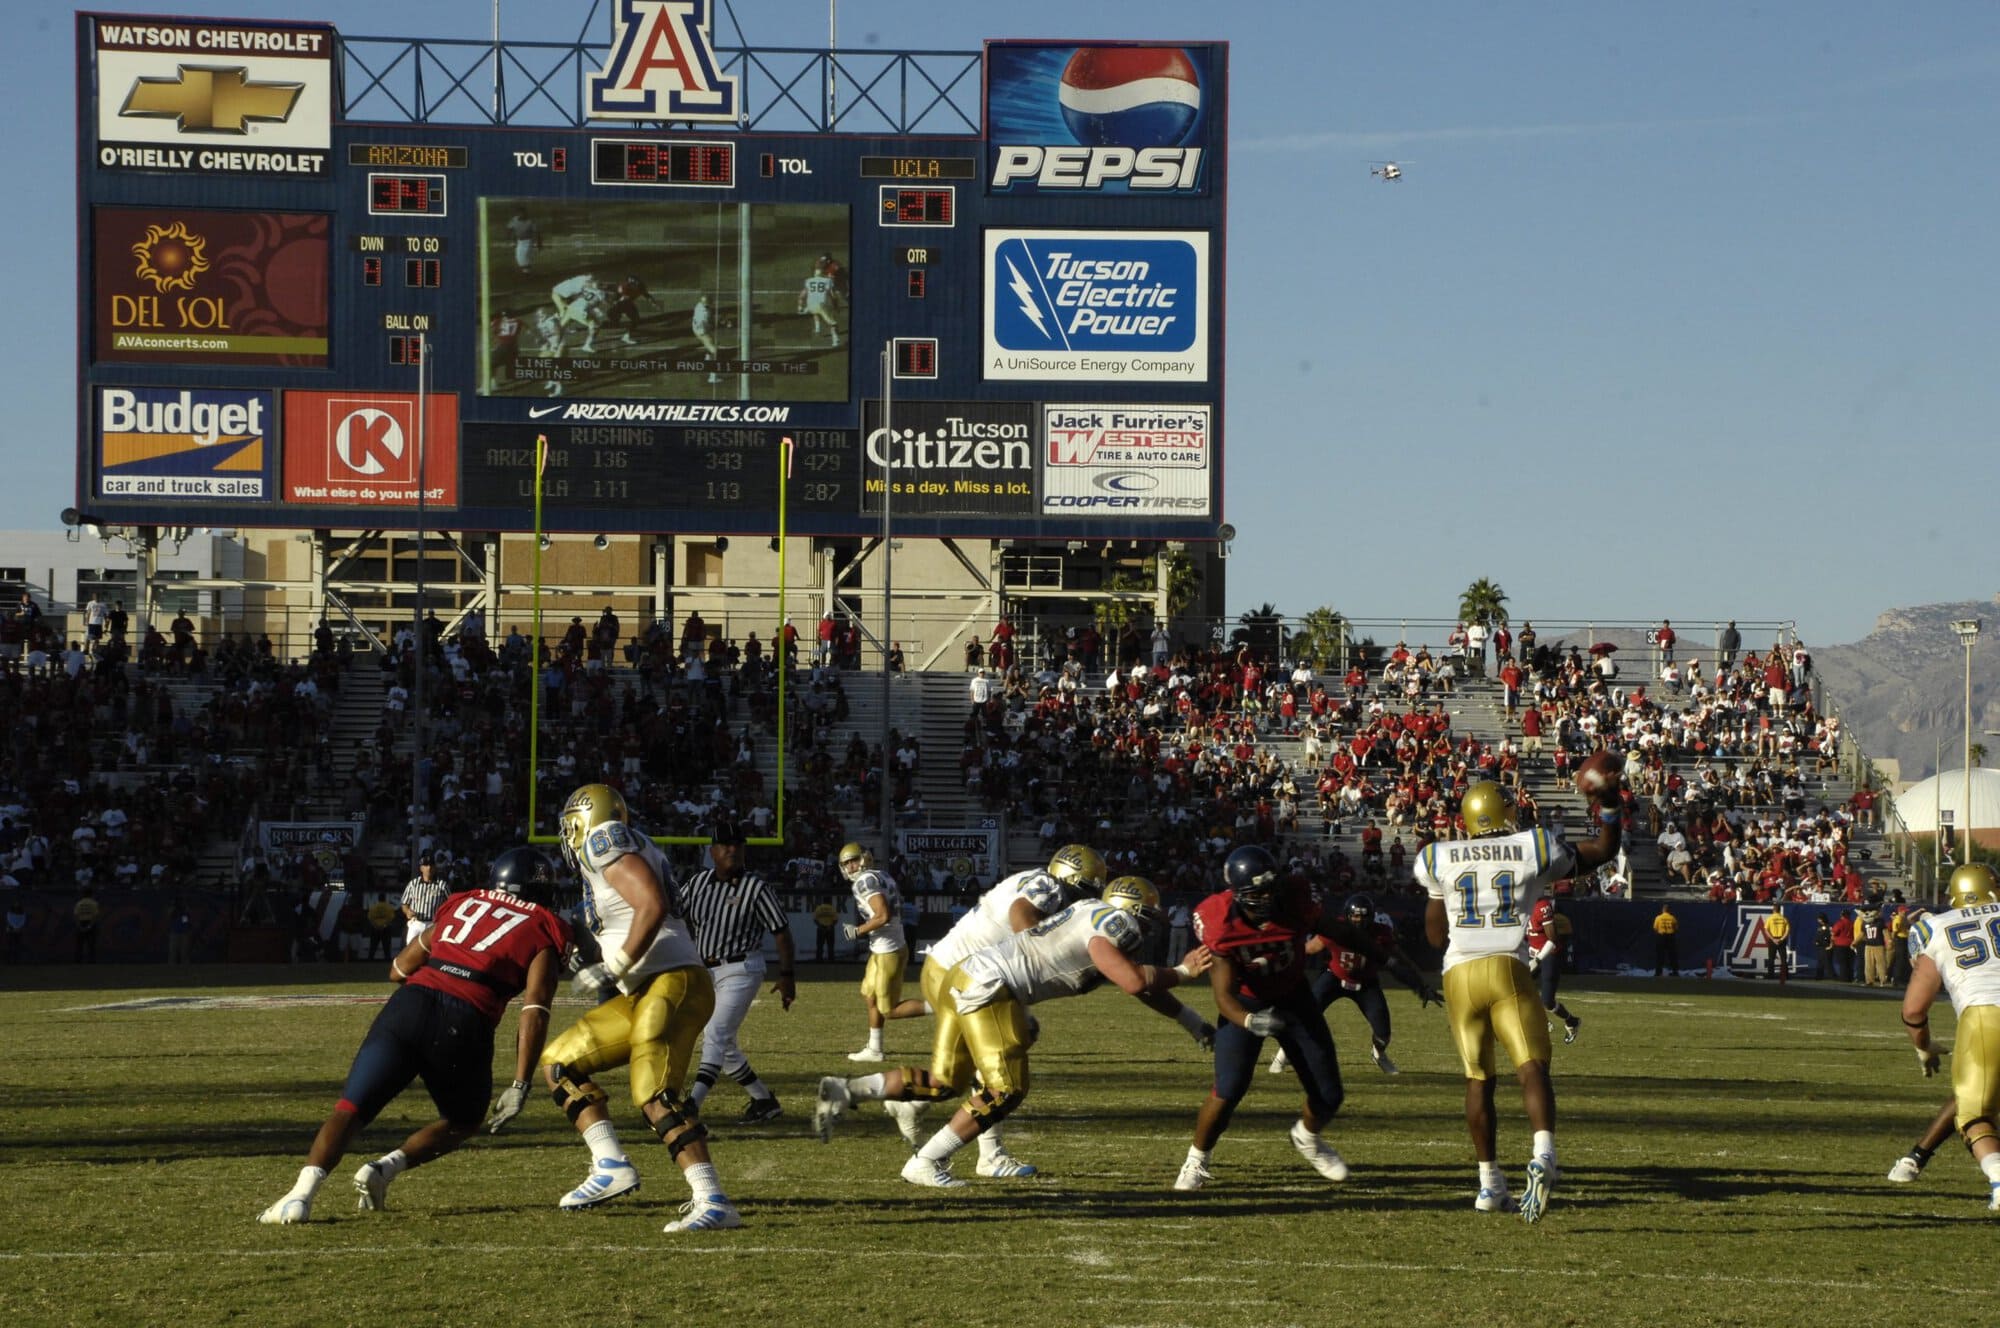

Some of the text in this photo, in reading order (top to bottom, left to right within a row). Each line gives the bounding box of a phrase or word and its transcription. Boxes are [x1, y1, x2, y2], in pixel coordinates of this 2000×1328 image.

[101, 25, 322, 52] WATSON CHEVROLET
[585, 0, 738, 120] A
[101, 147, 324, 173] O'RIELLY CHEVROLET
[368, 146, 449, 167] ARIZONA
[513, 152, 548, 169] TOL
[778, 159, 813, 175] TOL
[991, 146, 1202, 188] PEPSI
[892, 160, 940, 178] UCLA
[373, 179, 427, 209] 34
[898, 191, 952, 222] 27
[360, 236, 384, 251] DWN
[406, 237, 440, 252] TO GO
[907, 248, 927, 264] QTR
[1045, 252, 1149, 281] Tucson
[364, 258, 381, 286] 4
[909, 270, 925, 297] 4
[1056, 282, 1177, 308] Electric
[112, 295, 231, 329] DEL SOL
[1068, 309, 1176, 336] Power
[385, 315, 429, 331] BALL ON
[117, 336, 229, 351] AVAconcerts.com
[572, 359, 601, 369] NOW
[609, 360, 667, 370] FOURTH
[676, 360, 705, 370] AND
[742, 362, 771, 372] FOR
[782, 363, 809, 373] THE
[909, 343, 934, 372] 10
[993, 358, 1195, 375] A UniSource Energy Company
[515, 369, 577, 380] BRUINS.
[103, 388, 263, 446] Budget
[562, 403, 790, 423] ARIZONAATHLETICS.COM
[1051, 413, 1204, 431] Jack Furrier's
[570, 427, 851, 449] RUSHING PASSING TOTAL
[946, 417, 1029, 439] Tucson
[340, 409, 402, 475] K
[866, 427, 1033, 470] Citizen
[1050, 431, 1204, 464] WESTERN
[591, 450, 628, 468] 136
[705, 452, 743, 471] 343
[802, 453, 841, 471] 479
[1096, 450, 1201, 462] TIRE & AUTO CARE
[105, 478, 260, 496] car and truck sales
[293, 486, 328, 498] What
[330, 487, 357, 498] else
[360, 487, 377, 499] do
[379, 490, 402, 501] you
[592, 480, 629, 498] 111
[803, 483, 841, 502] 287
[905, 483, 915, 493] a
[919, 481, 950, 496] day.
[954, 480, 990, 494] Miss
[993, 484, 1004, 495] a
[1007, 481, 1031, 495] lot.
[1212, 626, 1224, 639] 29
[271, 828, 353, 847] BRUEGGR'S
[908, 835, 987, 851] BRUEGGER'S
[1450, 845, 1524, 863] RASSHAN
[1454, 870, 1522, 929] 11
[1961, 904, 1999, 918] REED
[440, 899, 530, 953] 97
